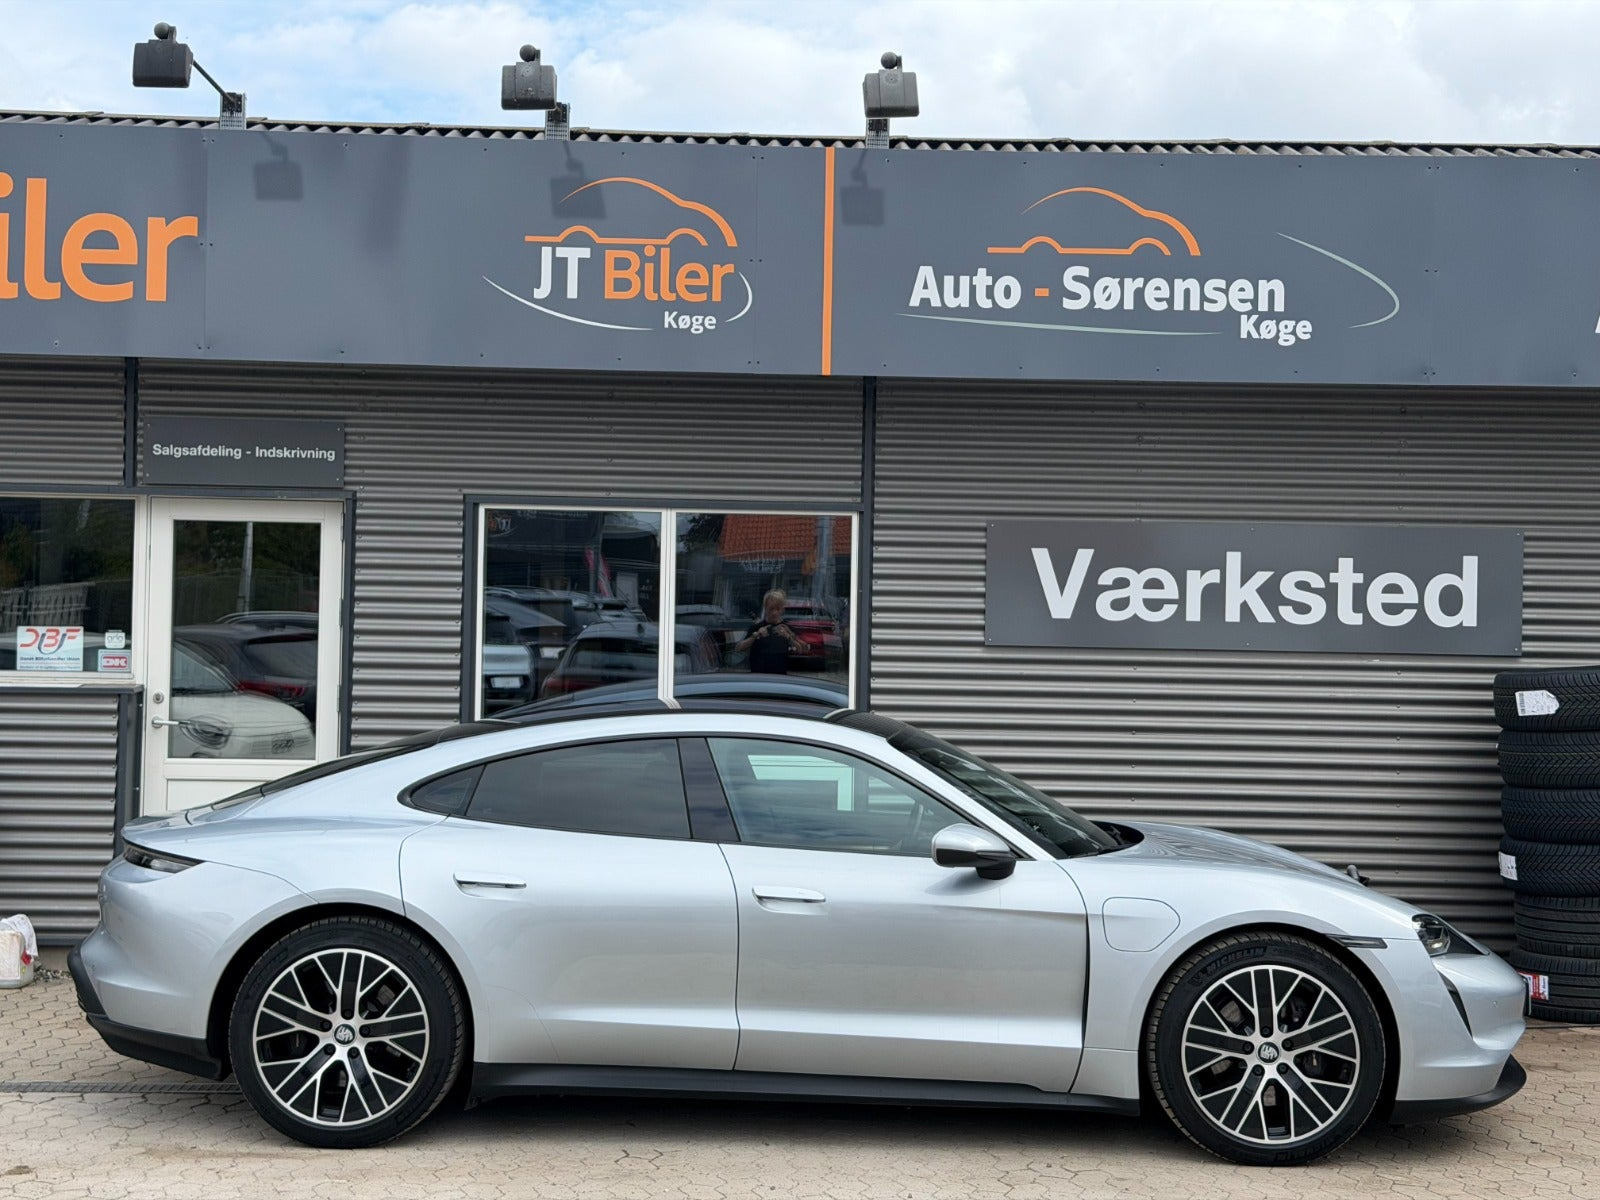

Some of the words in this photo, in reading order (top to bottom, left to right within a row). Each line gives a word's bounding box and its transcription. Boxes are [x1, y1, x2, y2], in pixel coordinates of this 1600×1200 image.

[533, 246, 591, 300] JT
[604, 245, 735, 303] Biler
[908, 265, 1022, 309] Auto
[1062, 266, 1285, 312] Sørensen
[664, 310, 717, 334] Køge
[1240, 314, 1313, 347] Køge
[152, 443, 242, 460] Salgsafdeling
[255, 446, 336, 462] Indskrivning
[1031, 547, 1479, 628] Værksted
